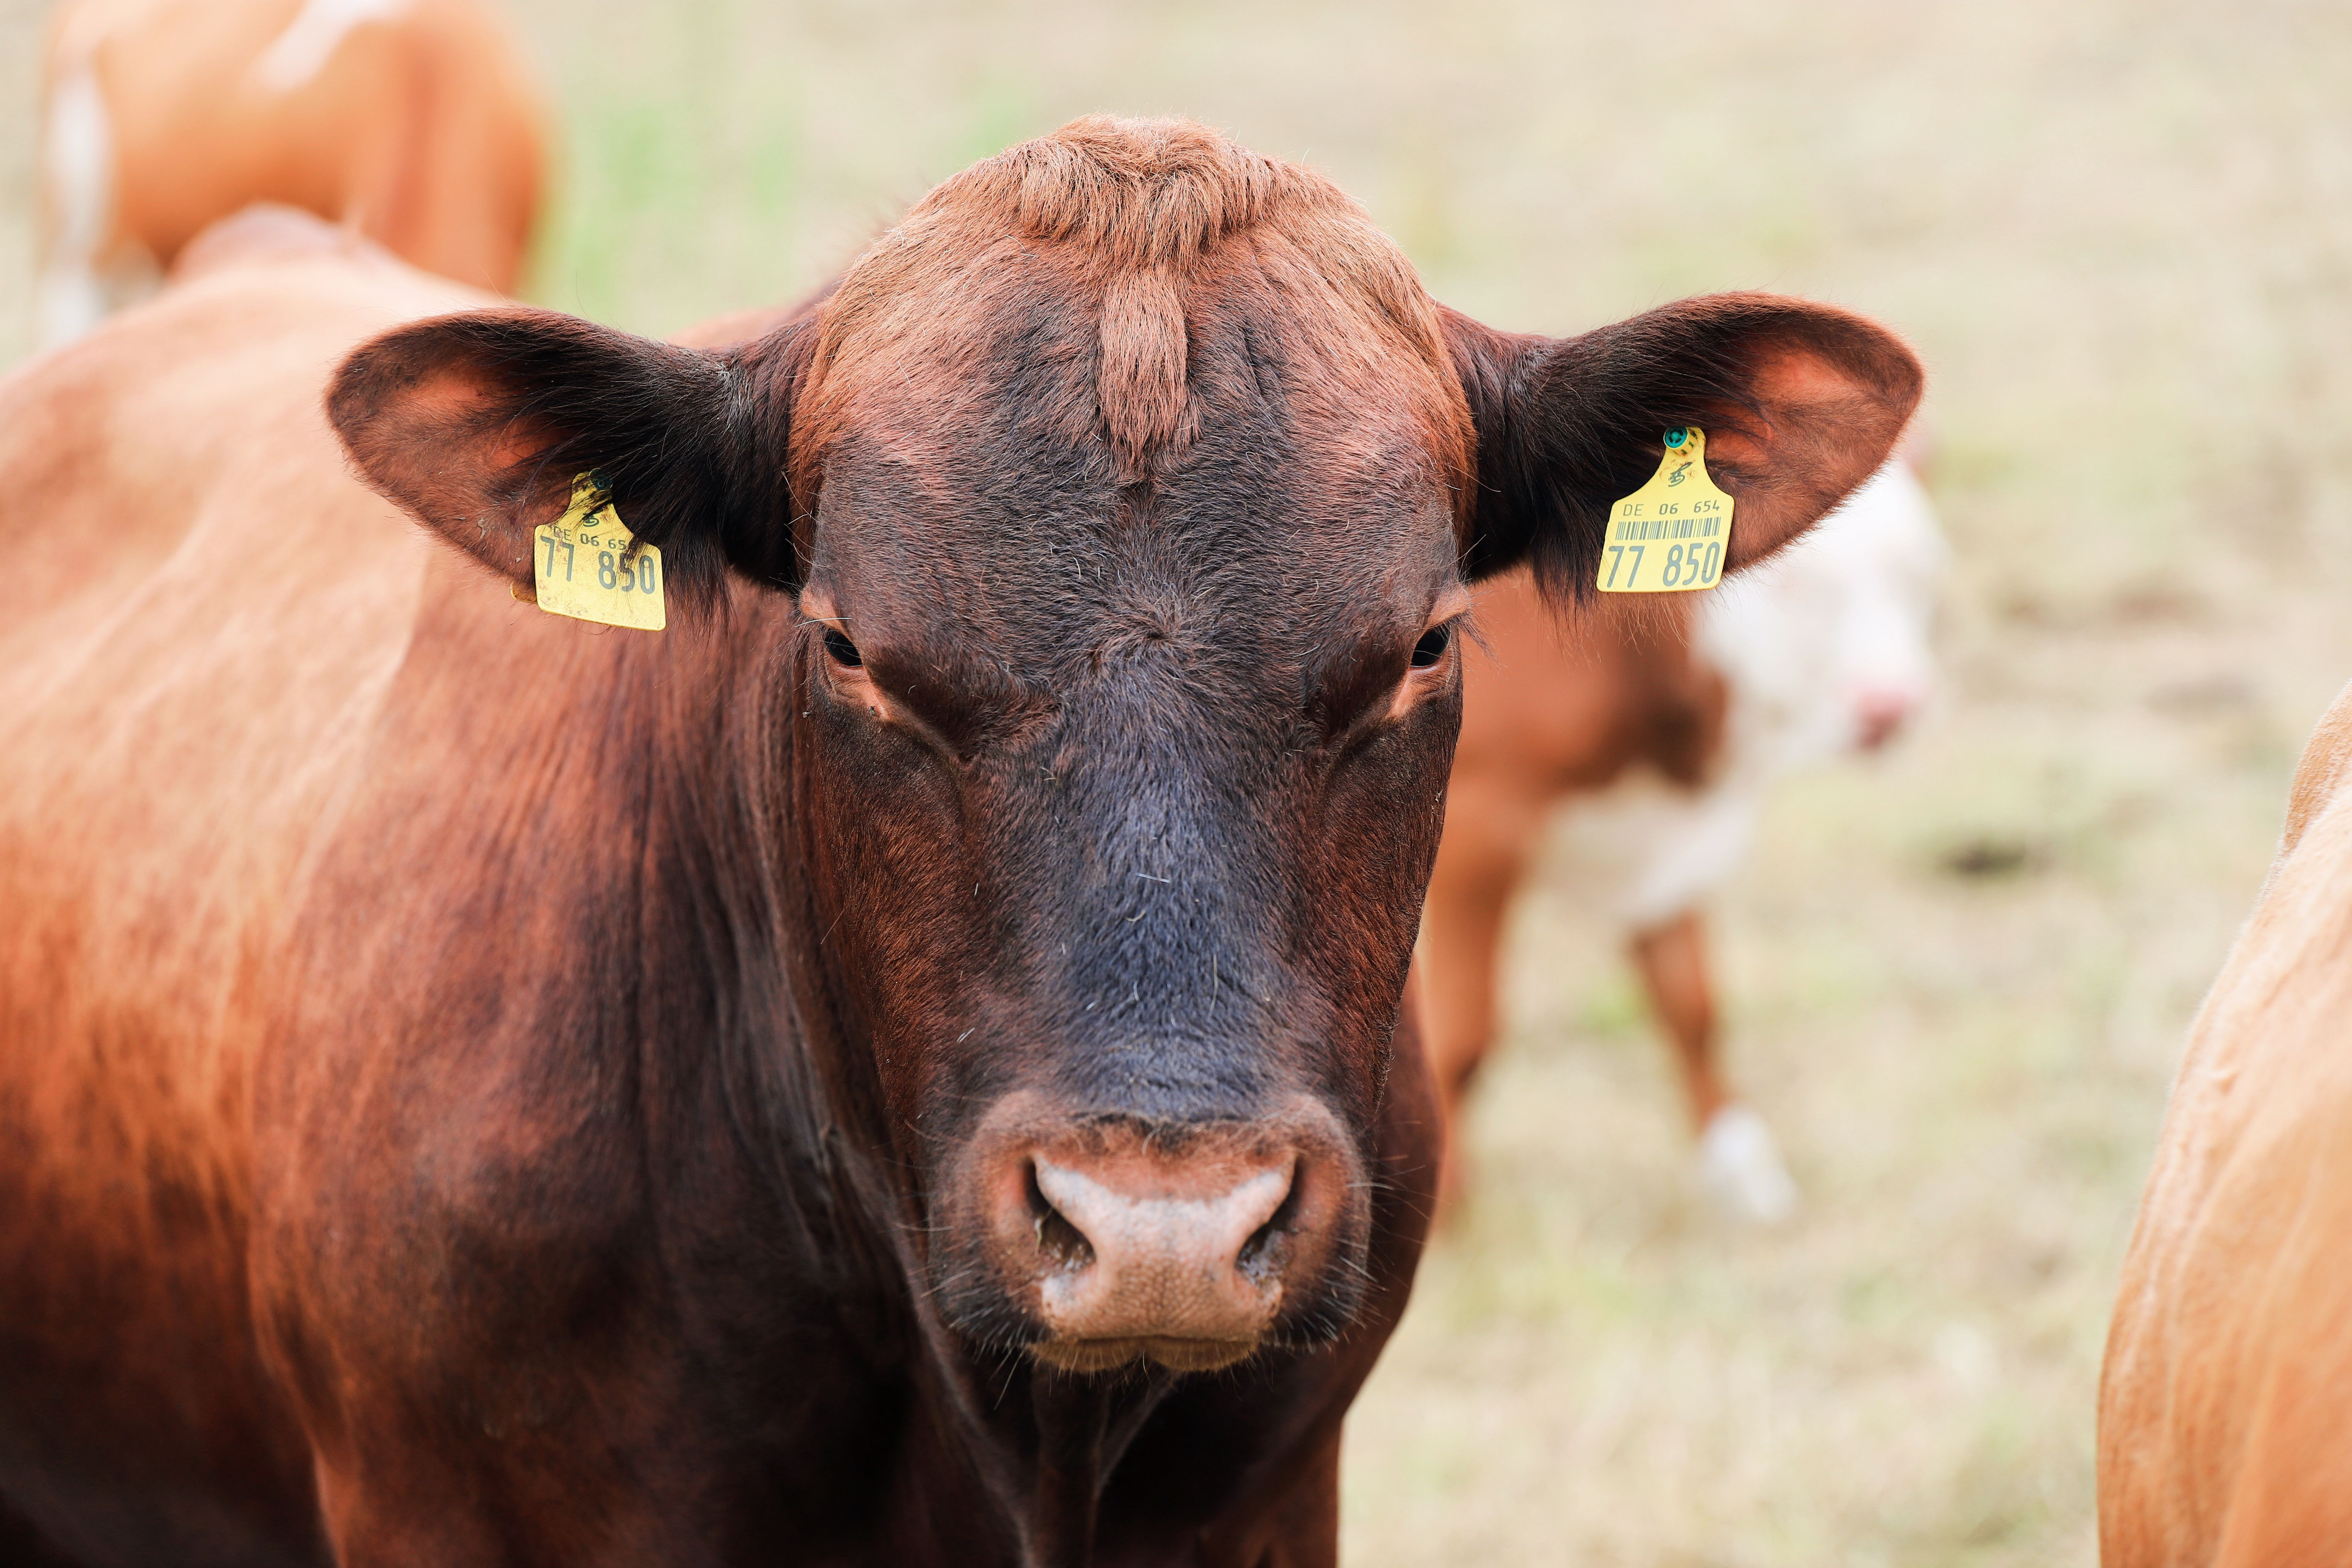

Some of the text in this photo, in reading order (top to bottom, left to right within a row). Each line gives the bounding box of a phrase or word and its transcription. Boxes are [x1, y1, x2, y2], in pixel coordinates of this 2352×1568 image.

[1623, 500, 1720, 516] DE 06 654
[554, 526, 635, 553] DE 06 65
[541, 536, 655, 594] 77 850
[1607, 542, 1720, 588] 77 850
